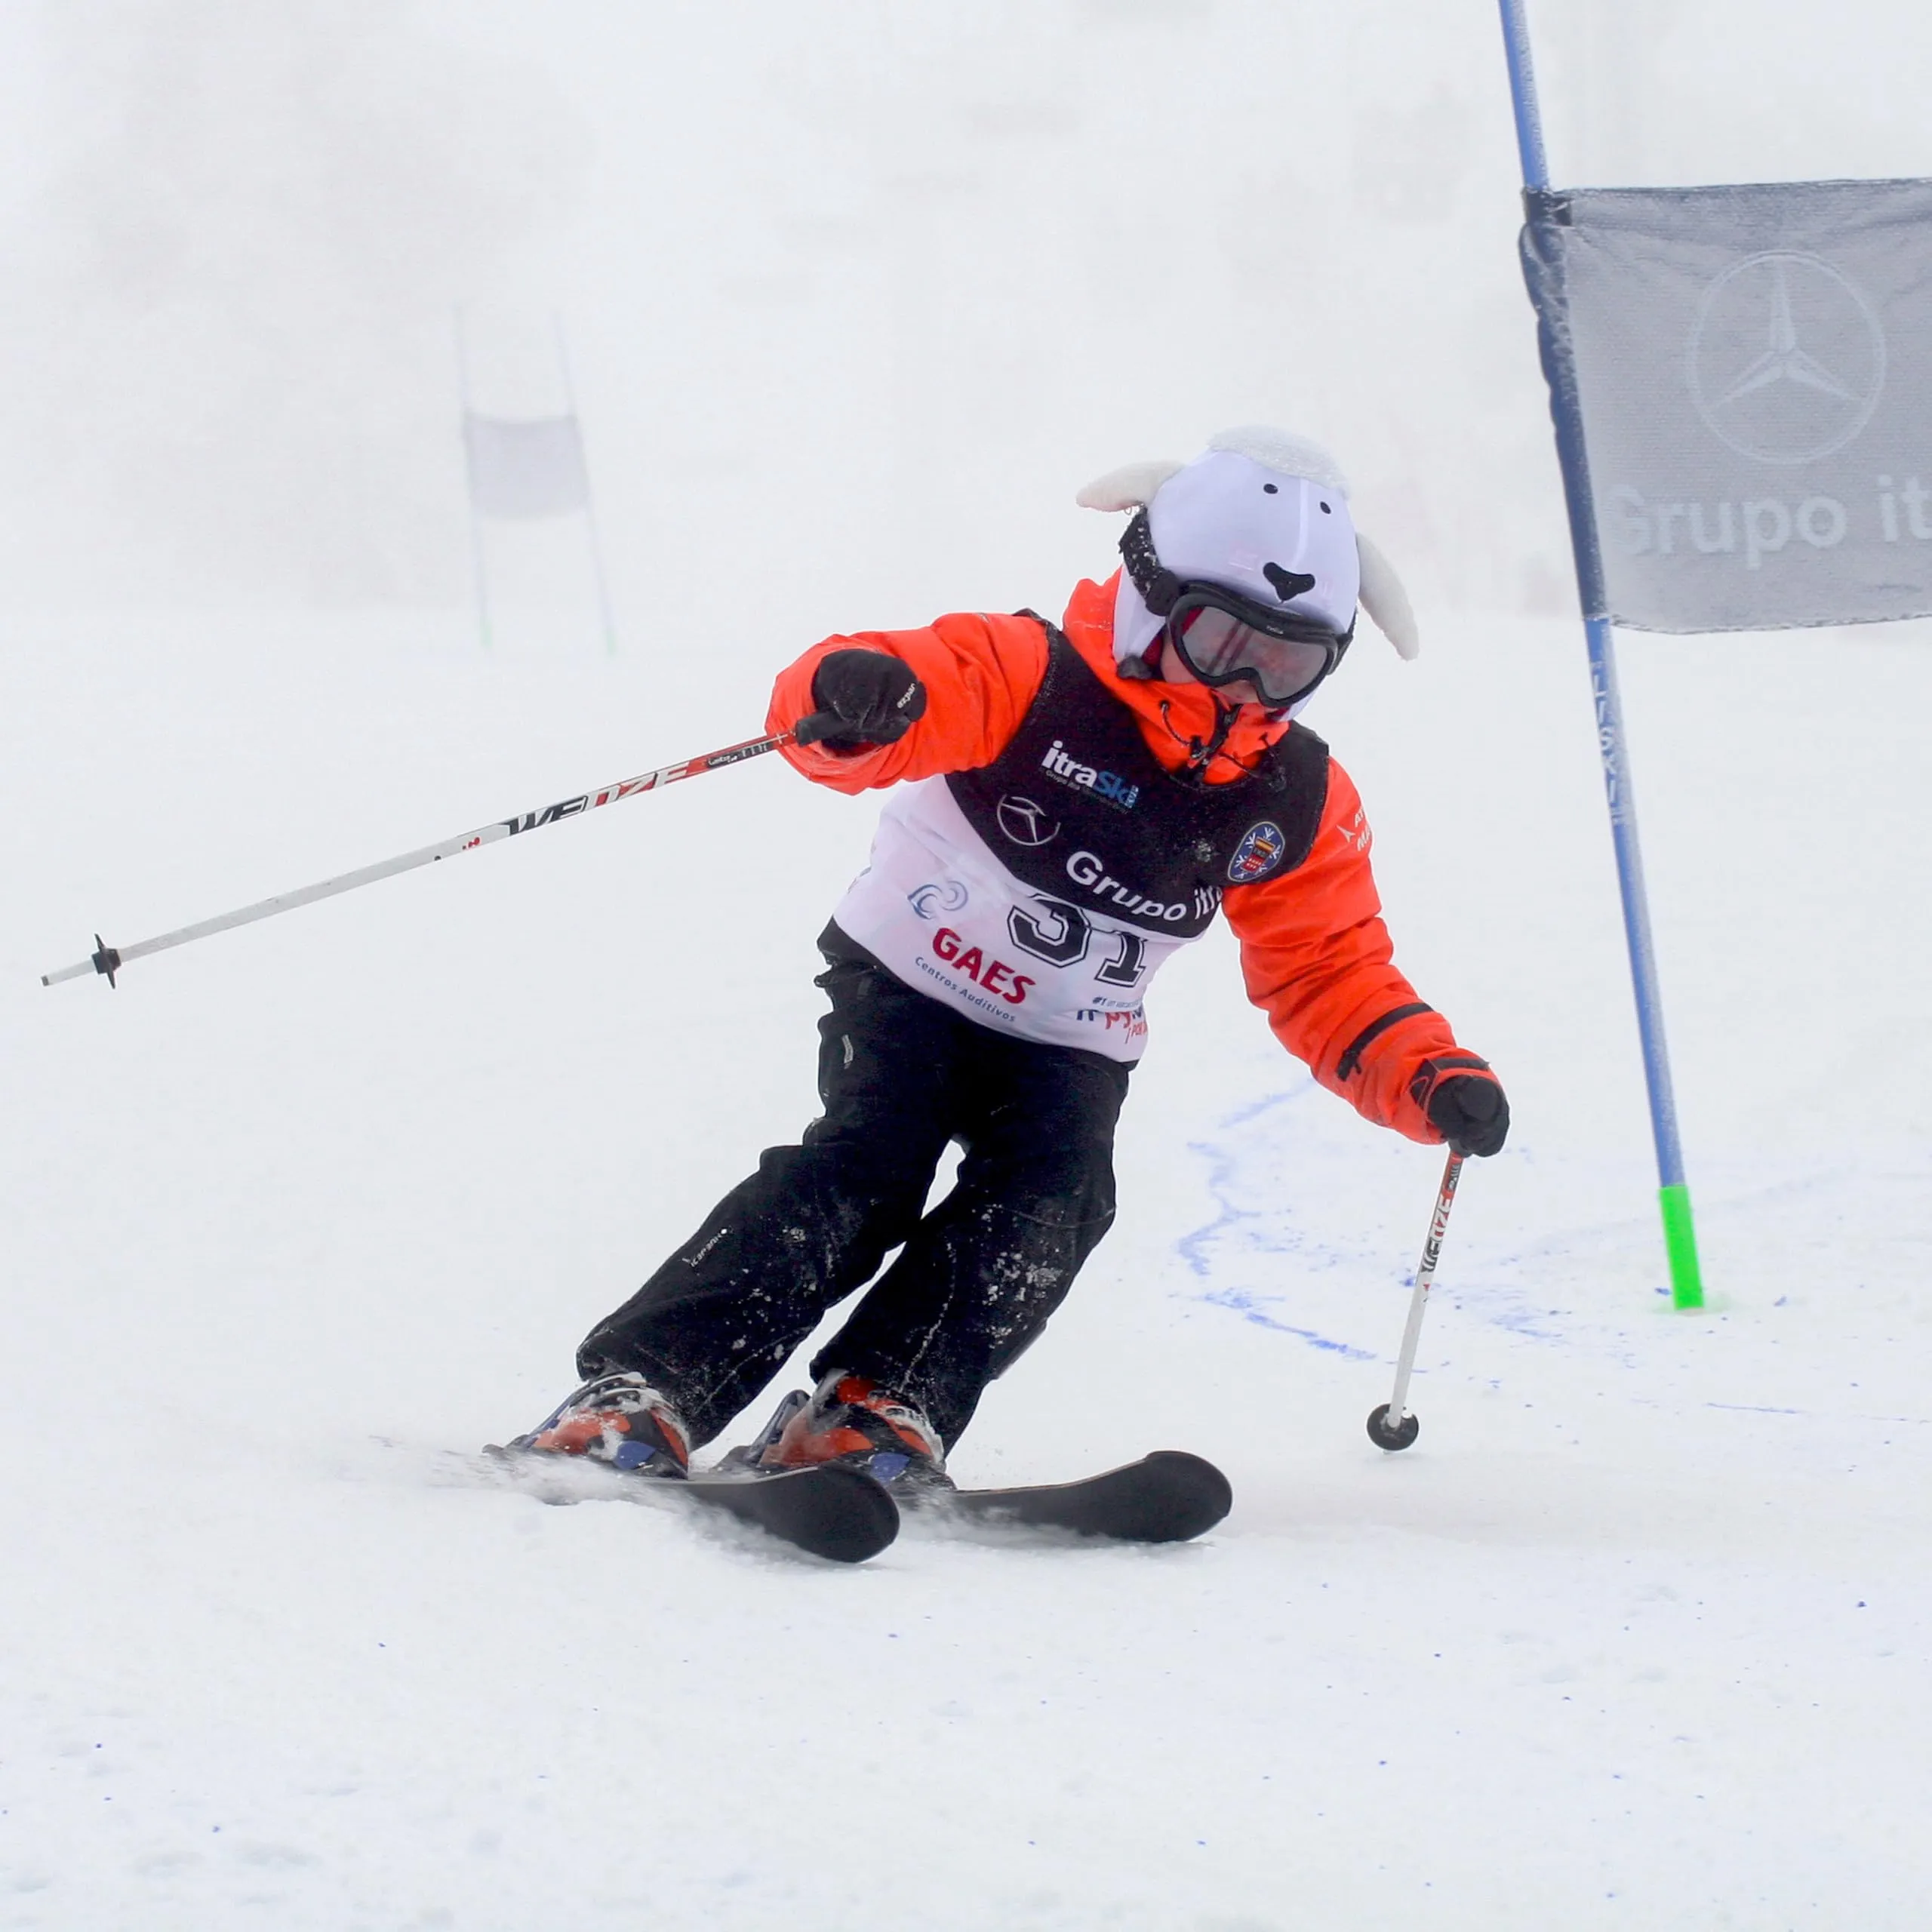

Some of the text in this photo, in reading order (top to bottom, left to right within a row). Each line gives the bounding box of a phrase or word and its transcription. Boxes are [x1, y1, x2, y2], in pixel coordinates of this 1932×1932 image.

[1604, 483, 1847, 571] Grupo
[1066, 851, 1187, 921] Grupo
[915, 956, 1017, 1023] Centros Auditivos
[932, 928, 1036, 1004] GAES
